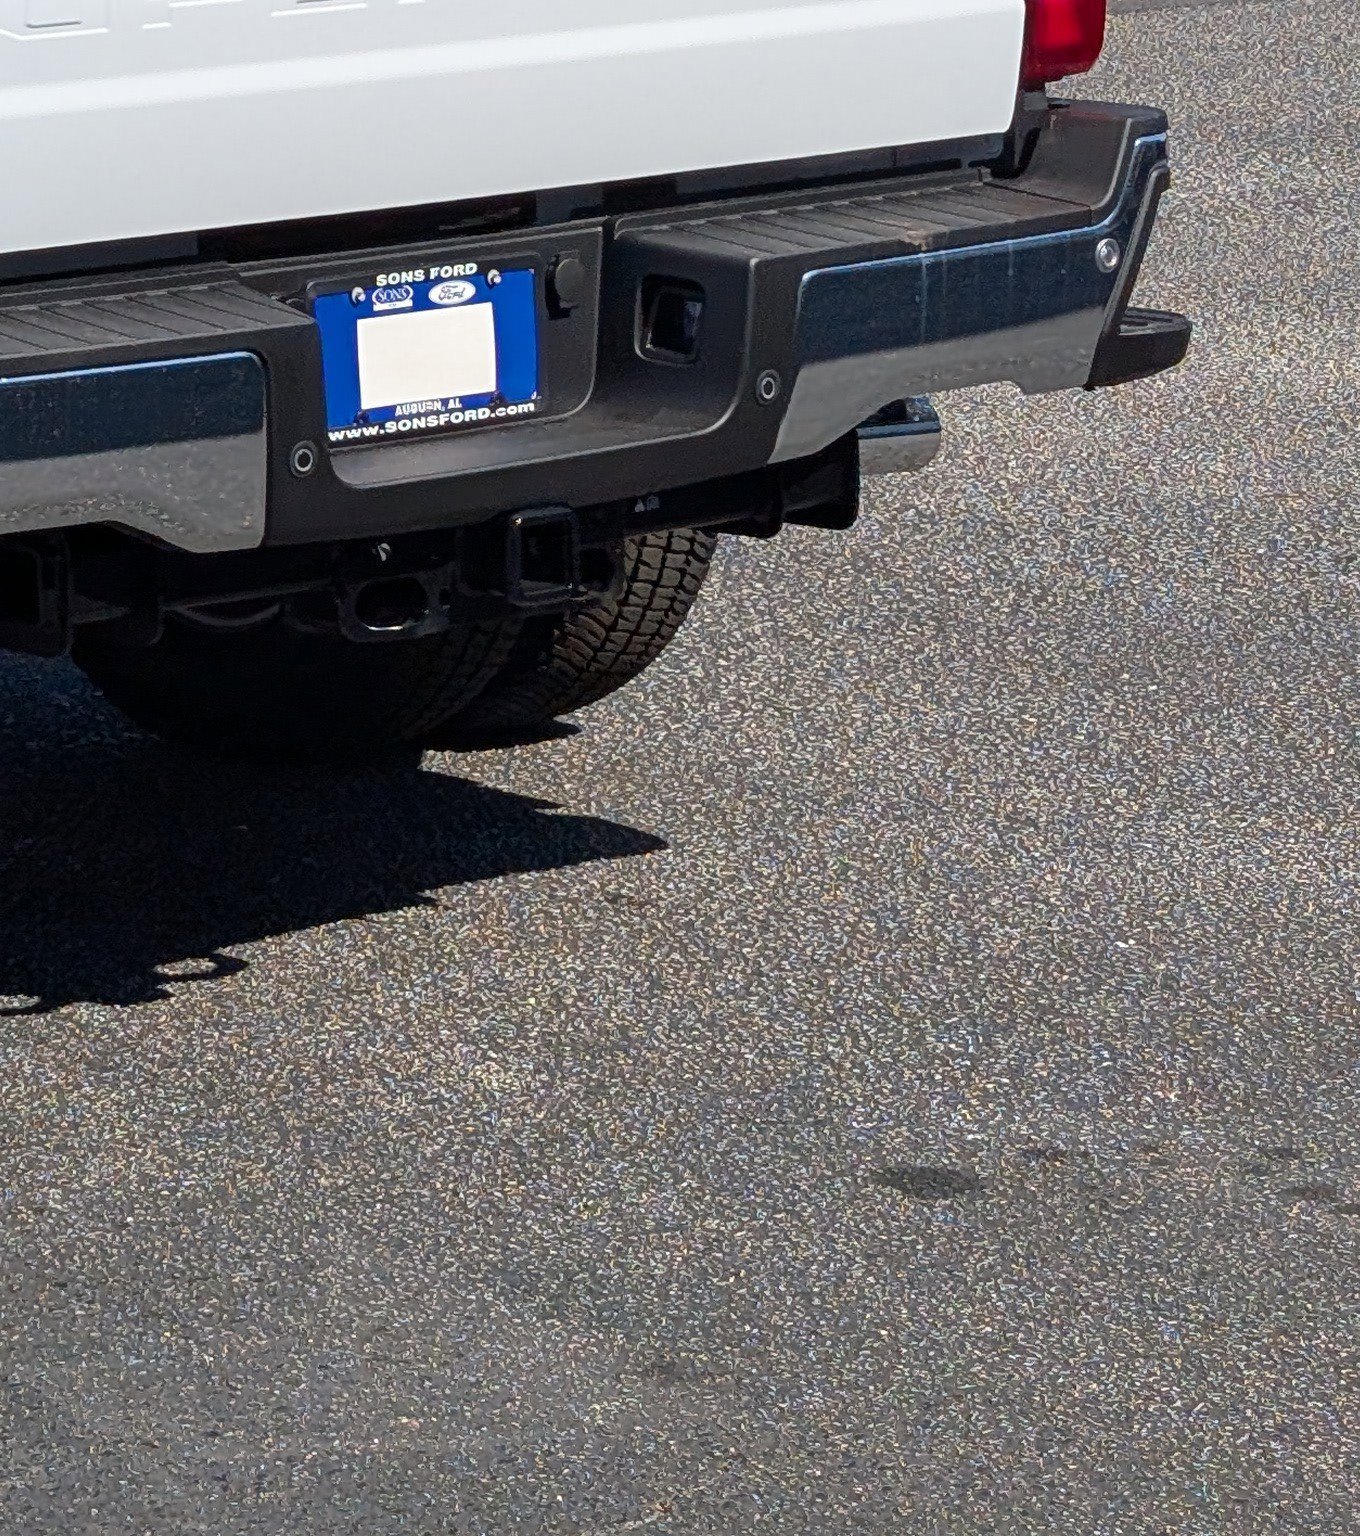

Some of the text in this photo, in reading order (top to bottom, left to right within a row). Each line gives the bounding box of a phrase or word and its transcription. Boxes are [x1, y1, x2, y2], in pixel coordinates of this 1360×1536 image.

[375, 262, 479, 287] SONS FORD
[377, 286, 408, 302] SONS
[438, 284, 467, 301] Ford
[447, 397, 463, 410] AL
[327, 402, 536, 442] www.SONSFORD.com
